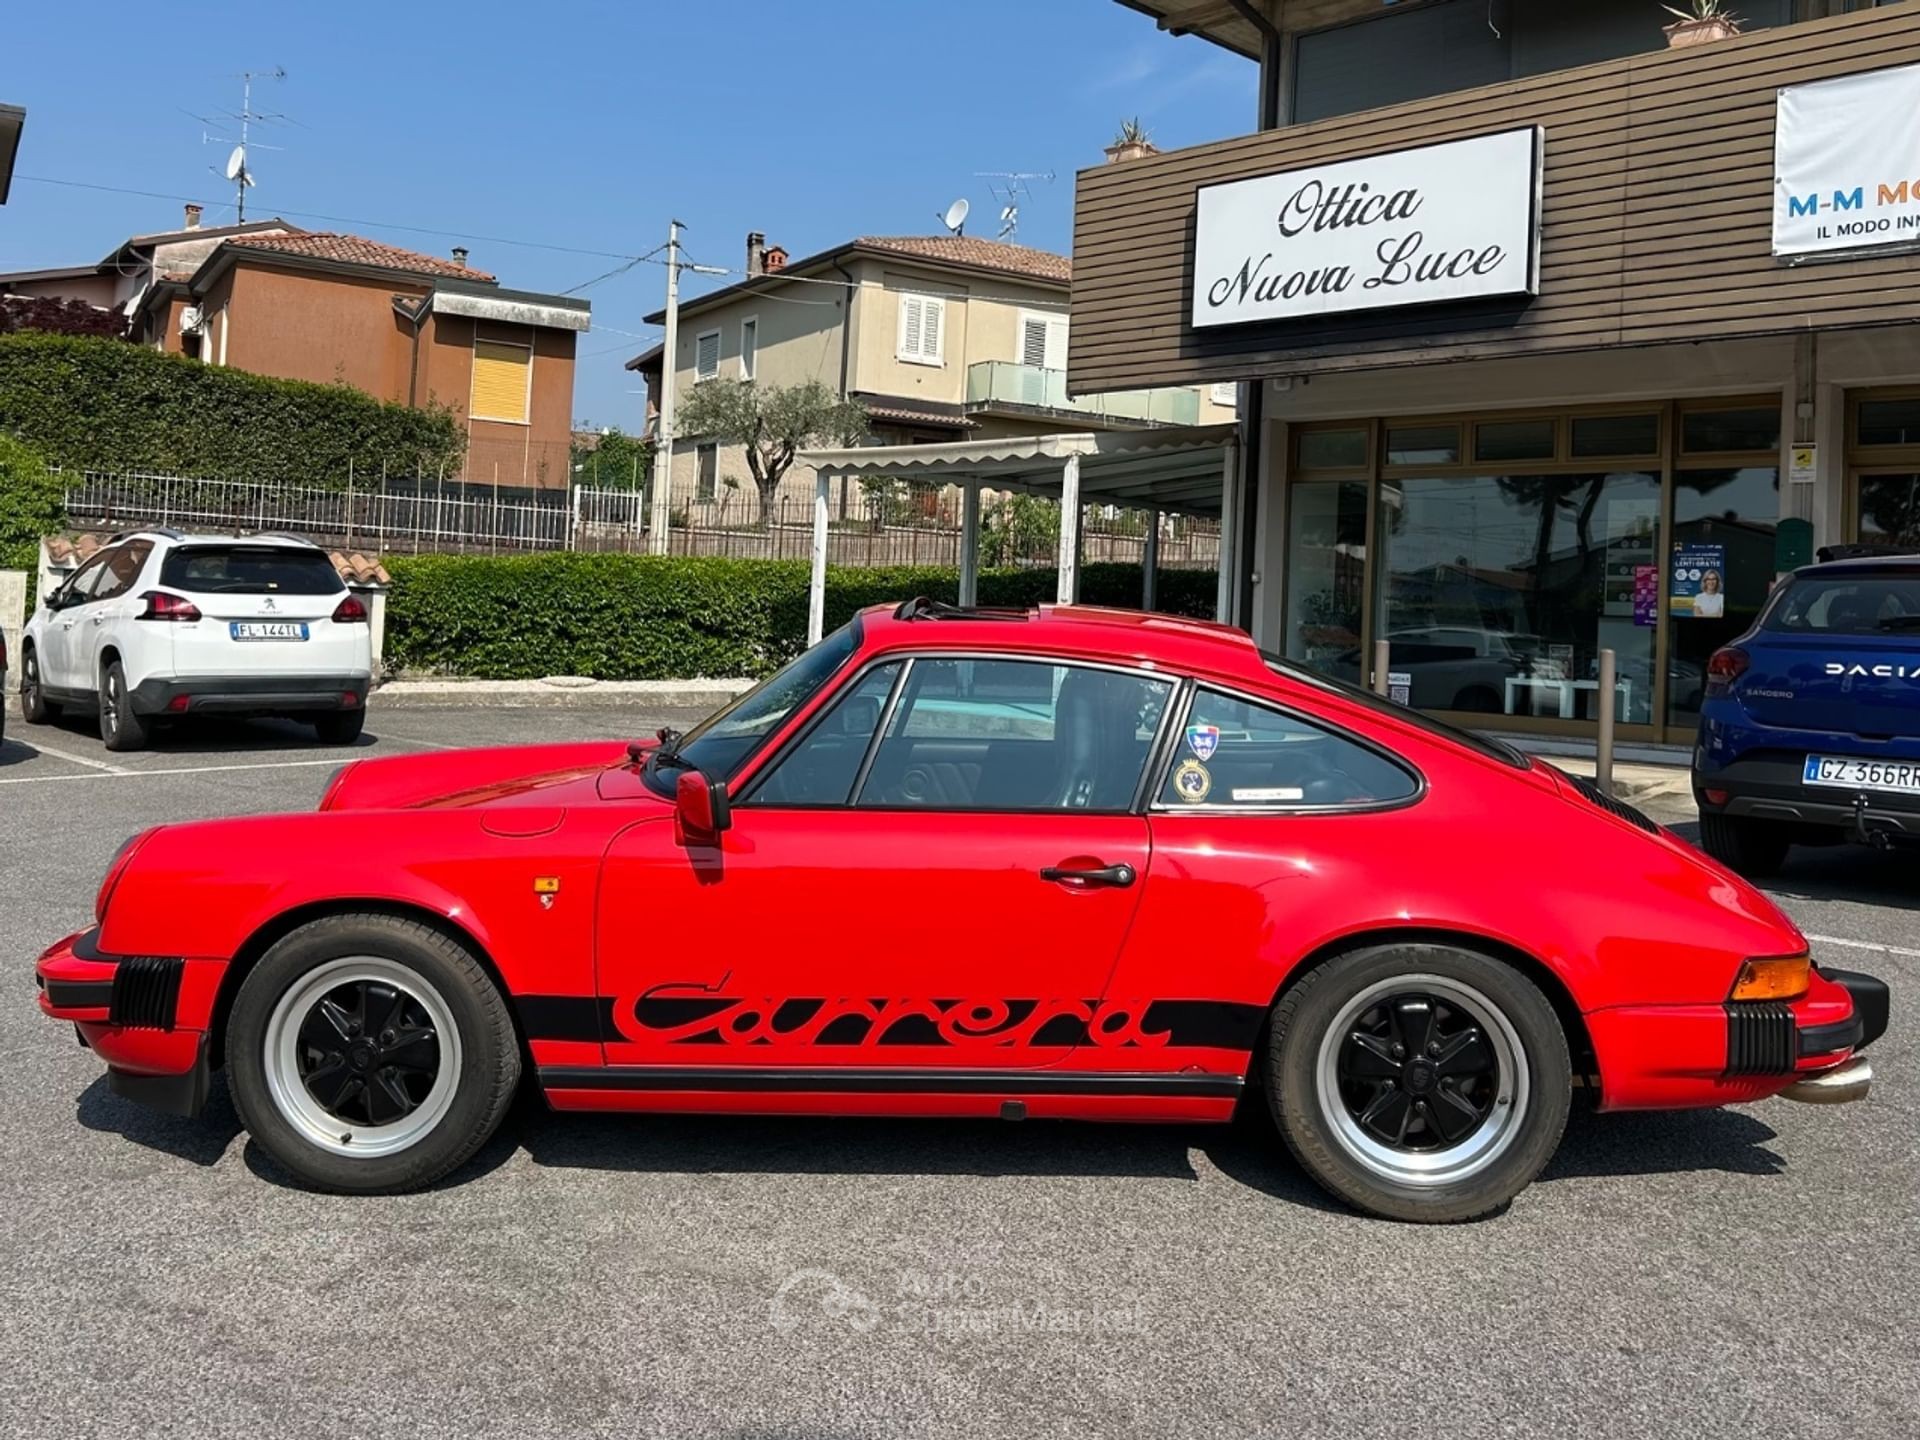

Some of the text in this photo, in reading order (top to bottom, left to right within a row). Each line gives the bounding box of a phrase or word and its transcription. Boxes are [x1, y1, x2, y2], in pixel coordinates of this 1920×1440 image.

[1278, 179, 1424, 238] Ottica
[1788, 186, 1863, 218] M-M
[1817, 226, 1831, 239] IL
[1837, 218, 1890, 237] MODO
[1208, 231, 1507, 308] Nuova Luce
[240, 625, 300, 637] FL 144TL
[1746, 689, 1794, 699] SANDERO
[1820, 760, 1850, 780] GZ
[613, 969, 1172, 1048] Carrera
